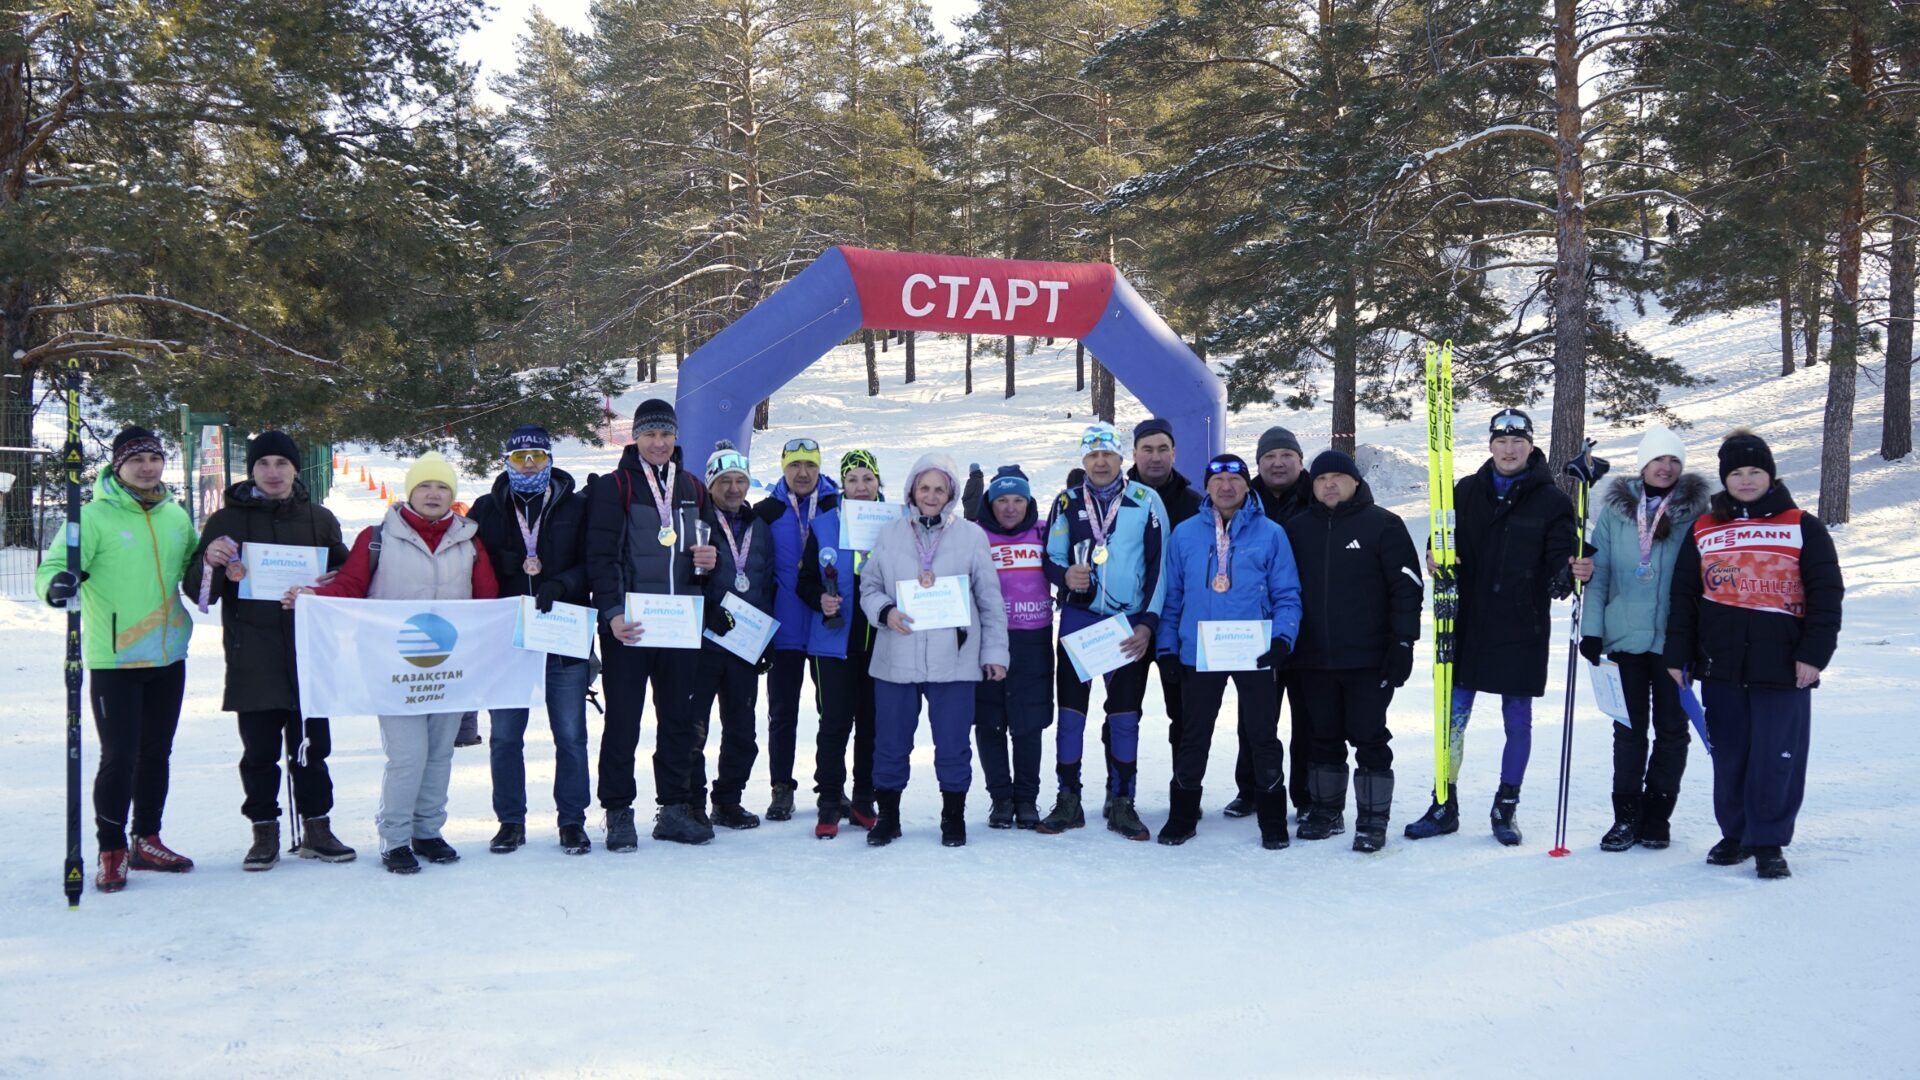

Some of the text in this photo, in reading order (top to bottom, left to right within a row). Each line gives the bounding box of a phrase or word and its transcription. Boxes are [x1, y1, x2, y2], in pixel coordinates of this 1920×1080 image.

[902, 273, 1069, 323] СТАРТ
[1429, 379, 1439, 452] FISCHER
[1443, 377, 1452, 452] FISCHER
[1700, 529, 1792, 550] VIESSMANN
[261, 558, 307, 568] ДИПЛОМ
[643, 607, 685, 616] ДИПЛОМ
[1214, 633, 1254, 641] ДИПЛОМ
[391, 669, 464, 684] ҚАЗАҚСТАН
[409, 683, 446, 693] ТЕМІР
[404, 692, 446, 704] ЖОЛЫ
